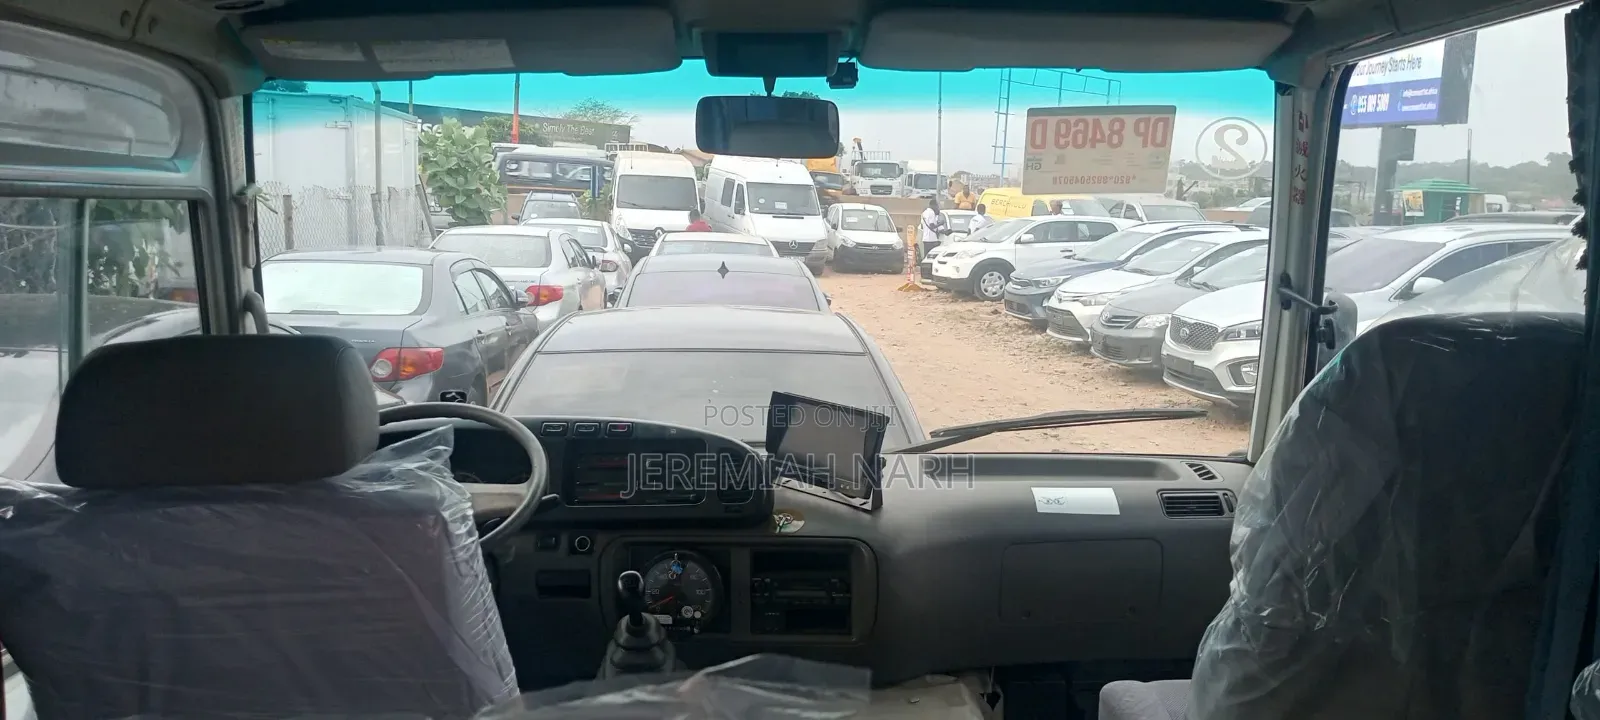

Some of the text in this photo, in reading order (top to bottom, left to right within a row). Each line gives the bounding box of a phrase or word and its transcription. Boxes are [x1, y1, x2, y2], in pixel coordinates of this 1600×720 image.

[1353, 54, 1422, 76] our Journey Starts Here
[542, 122, 595, 136] Simply The Best
